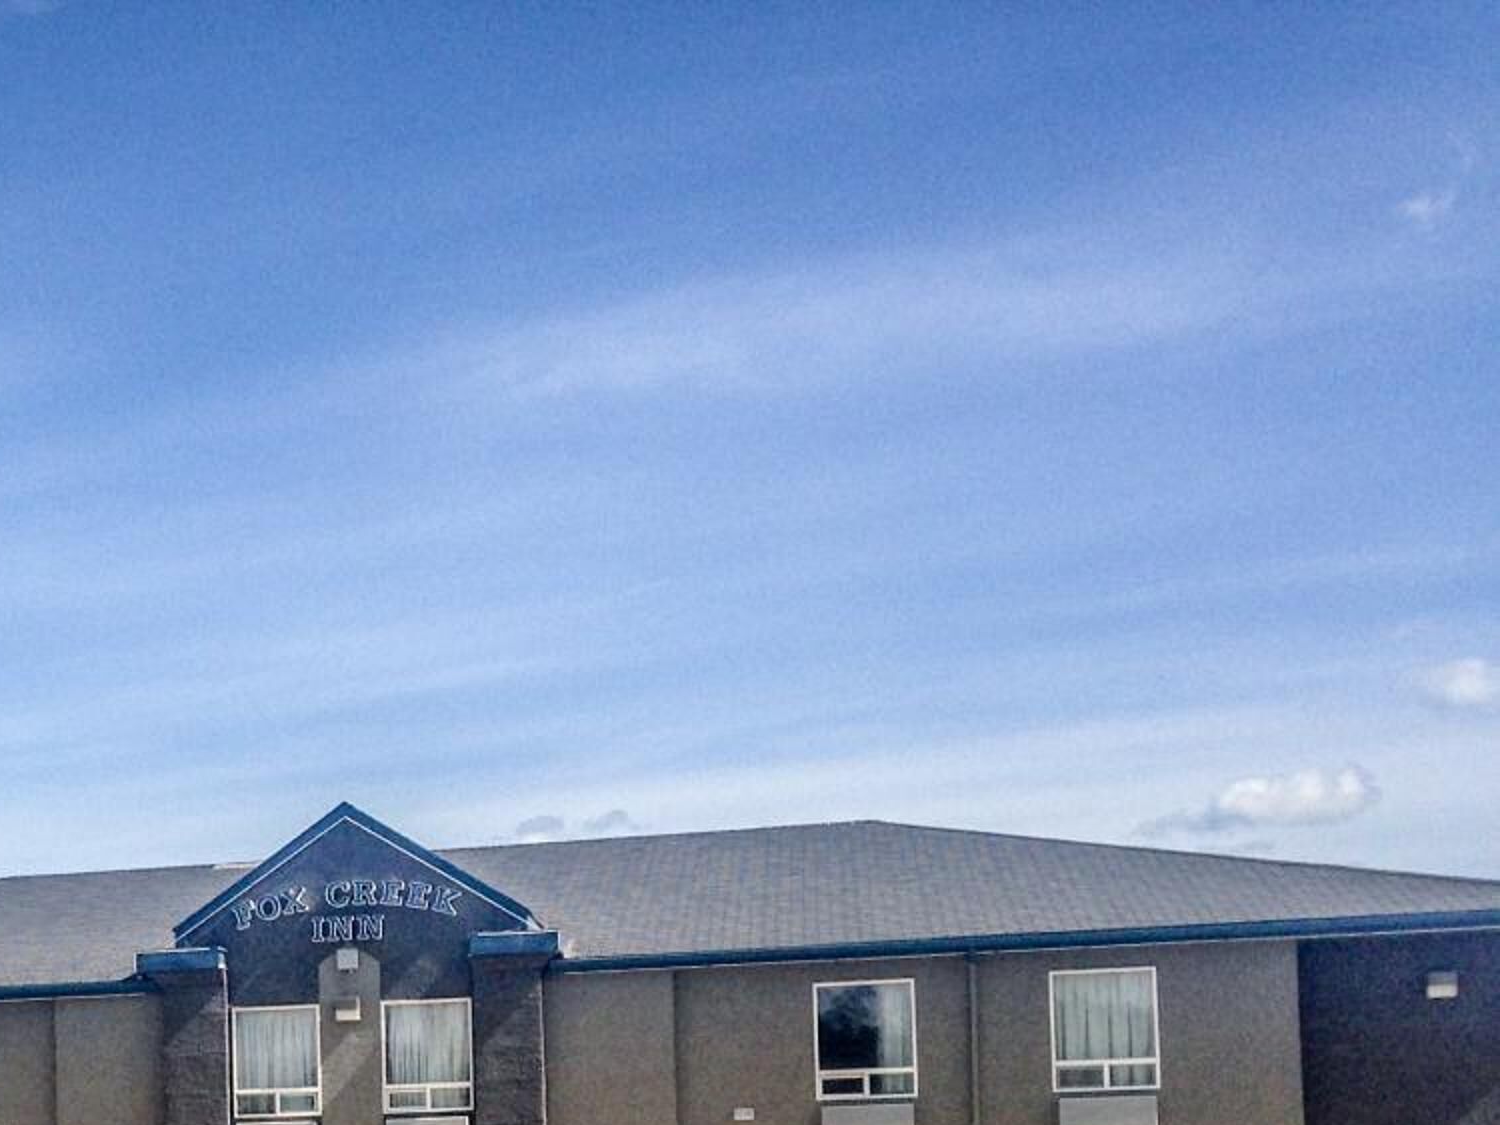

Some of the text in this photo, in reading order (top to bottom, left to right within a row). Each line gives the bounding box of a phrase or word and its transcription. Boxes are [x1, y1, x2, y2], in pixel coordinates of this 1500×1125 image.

[232, 880, 462, 932] FOX CREEK
[311, 914, 385, 943] INN
